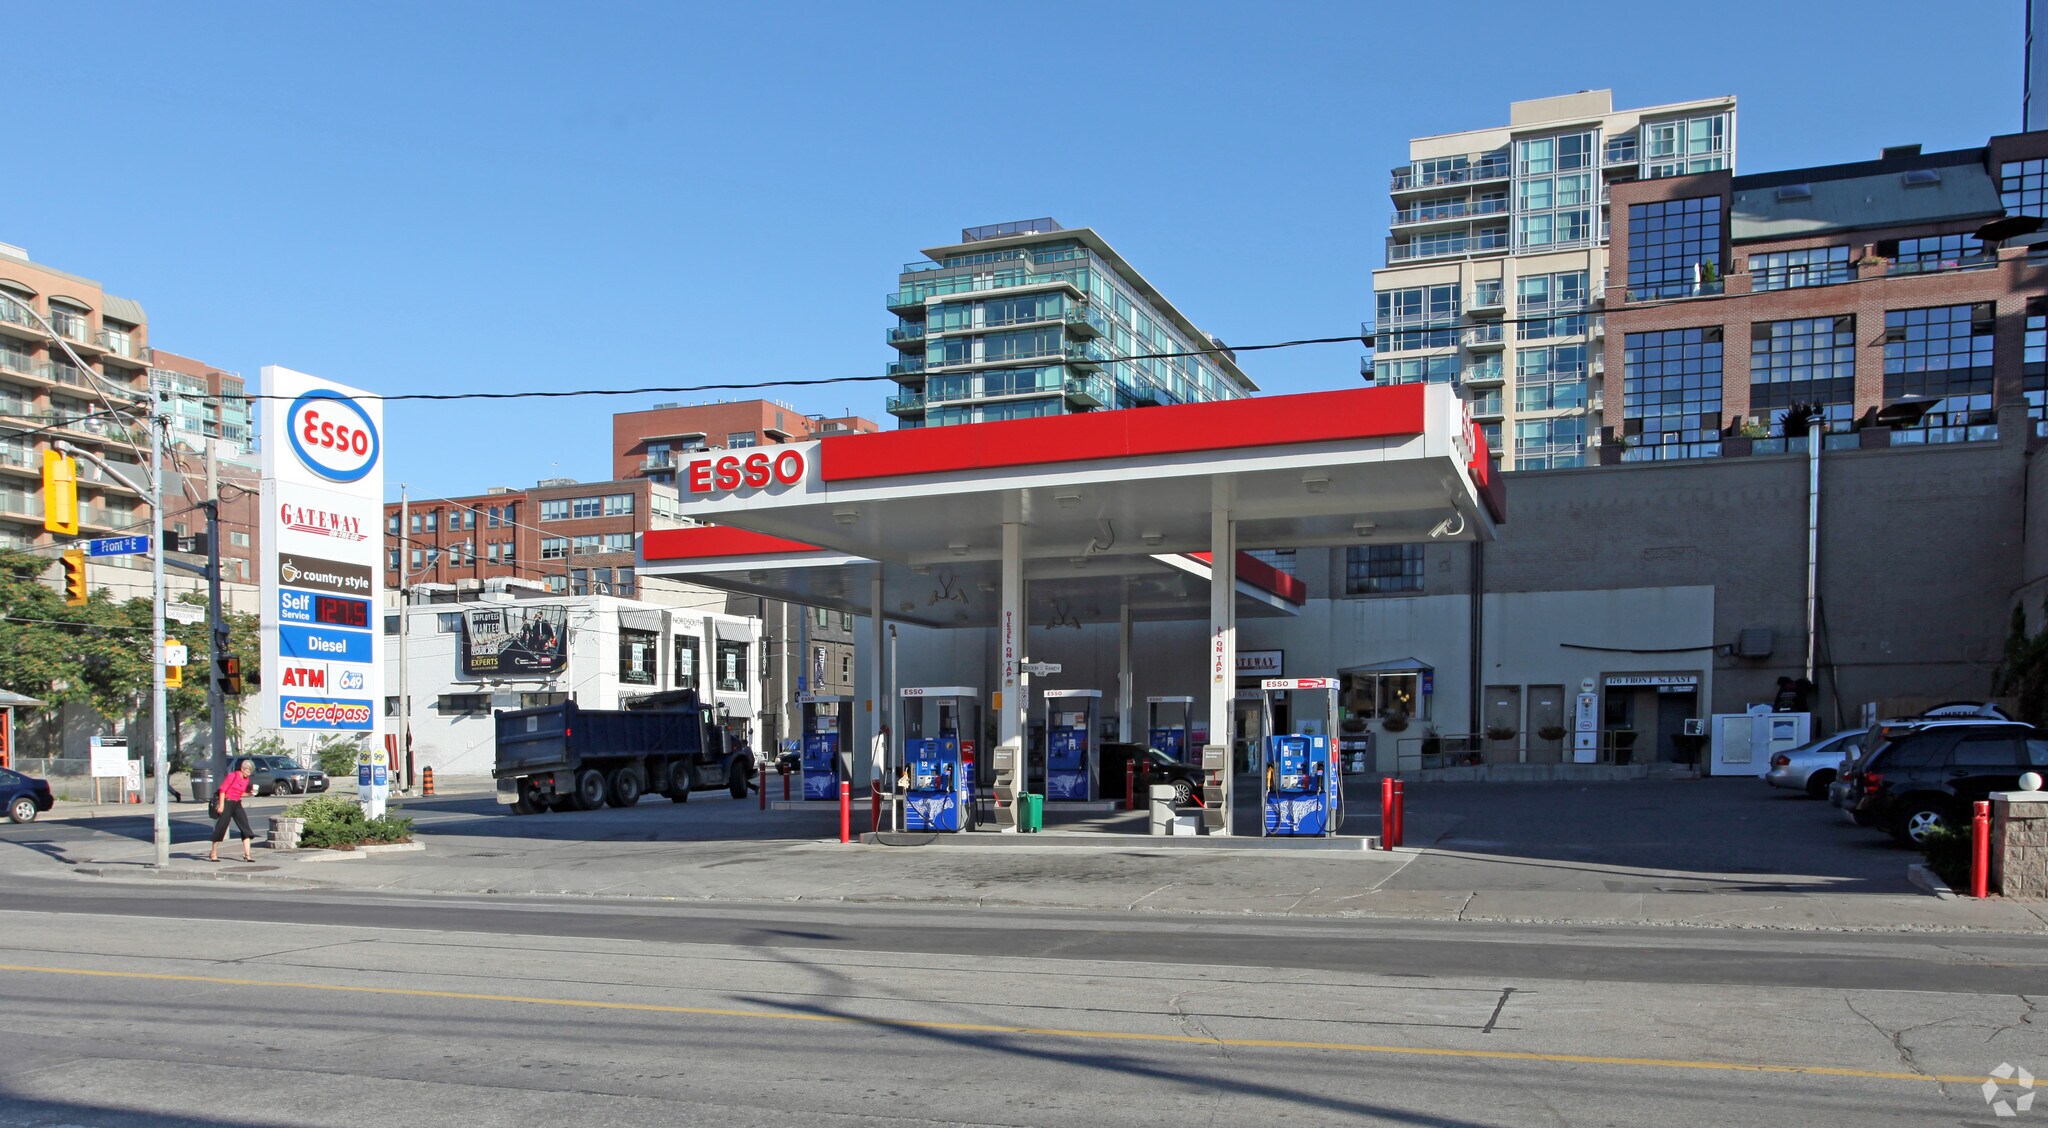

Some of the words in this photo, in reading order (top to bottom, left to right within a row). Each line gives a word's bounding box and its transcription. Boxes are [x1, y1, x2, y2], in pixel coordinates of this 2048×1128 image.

[689, 449, 805, 493] ESSO
[101, 540, 124, 552] Front
[131, 537, 137, 550] E
[303, 571, 344, 588] country
[344, 576, 369, 590] style
[282, 592, 310, 611] Self
[281, 609, 310, 621] Service
[473, 623, 500, 634] WANTED
[308, 635, 348, 654] Diesel
[1216, 640, 1223, 653] ON
[1006, 646, 1013, 659] ON
[471, 657, 499, 667] EXPERTS
[1215, 655, 1223, 673] TAP
[1235, 656, 1275, 667] ATEWAY
[1005, 660, 1013, 678] TAP
[282, 667, 325, 688] ATM
[1266, 680, 1289, 688] ESSO
[1625, 676, 1652, 684] FRONT
[904, 688, 924, 696] ESSO
[284, 700, 371, 724] Speedpass
